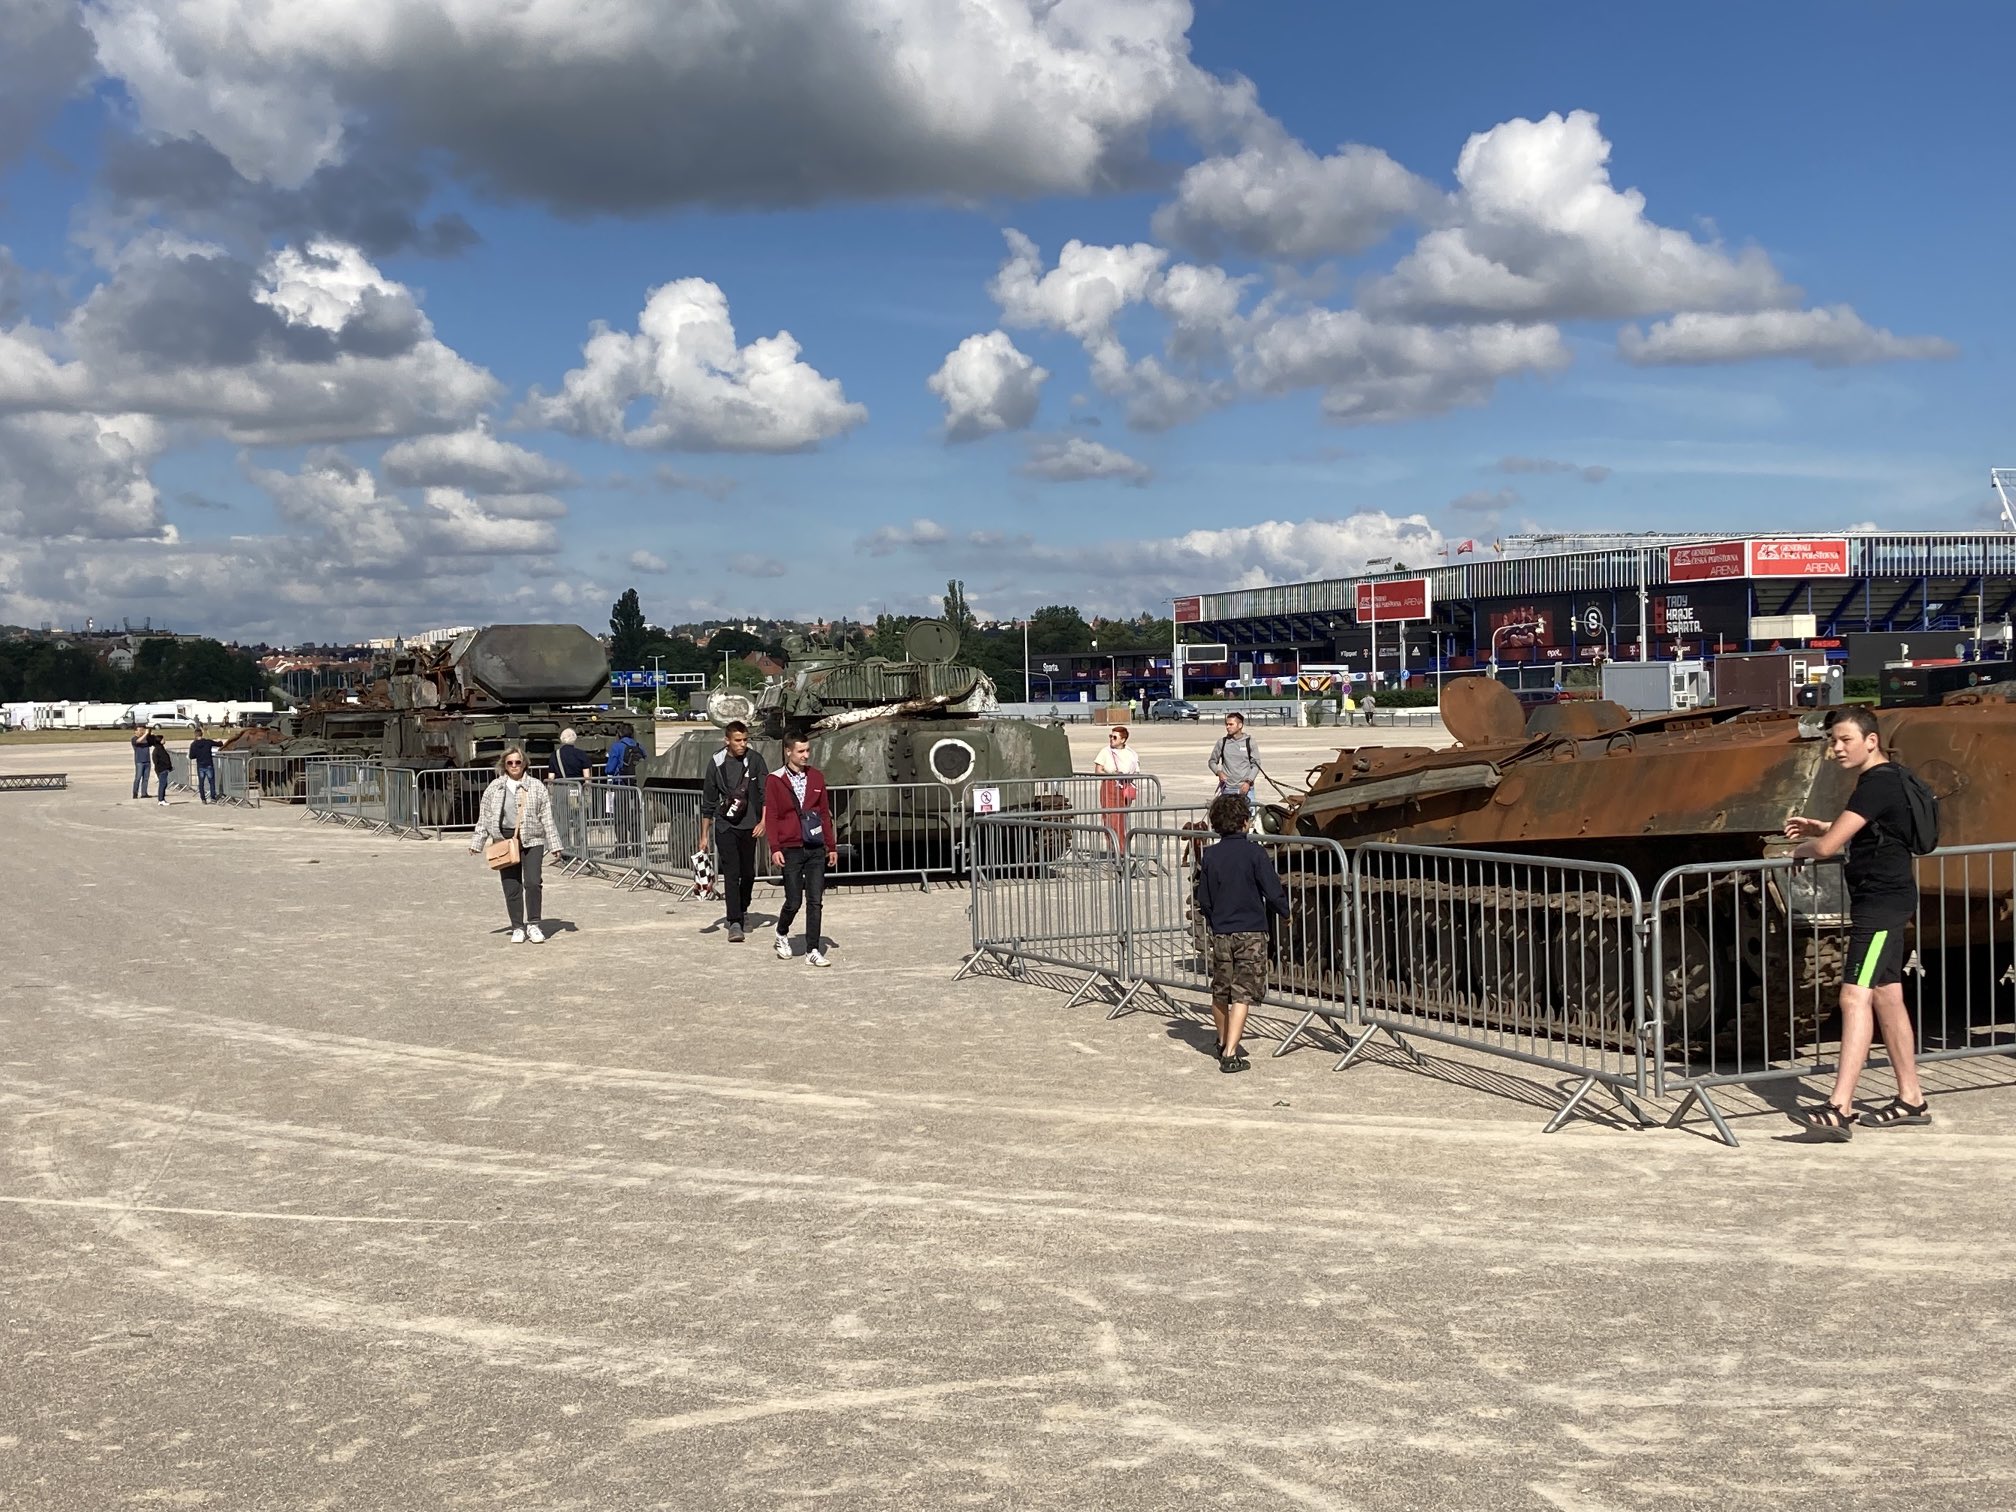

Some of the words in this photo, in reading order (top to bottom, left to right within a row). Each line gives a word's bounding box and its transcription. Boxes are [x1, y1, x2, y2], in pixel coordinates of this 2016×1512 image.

[1710, 565, 1740, 576] ARENA
[1804, 562, 1841, 573] ARENA
[1666, 595, 1688, 608] TADY
[1666, 608, 1694, 621] HRAJE
[726, 798, 741, 817] FILA
